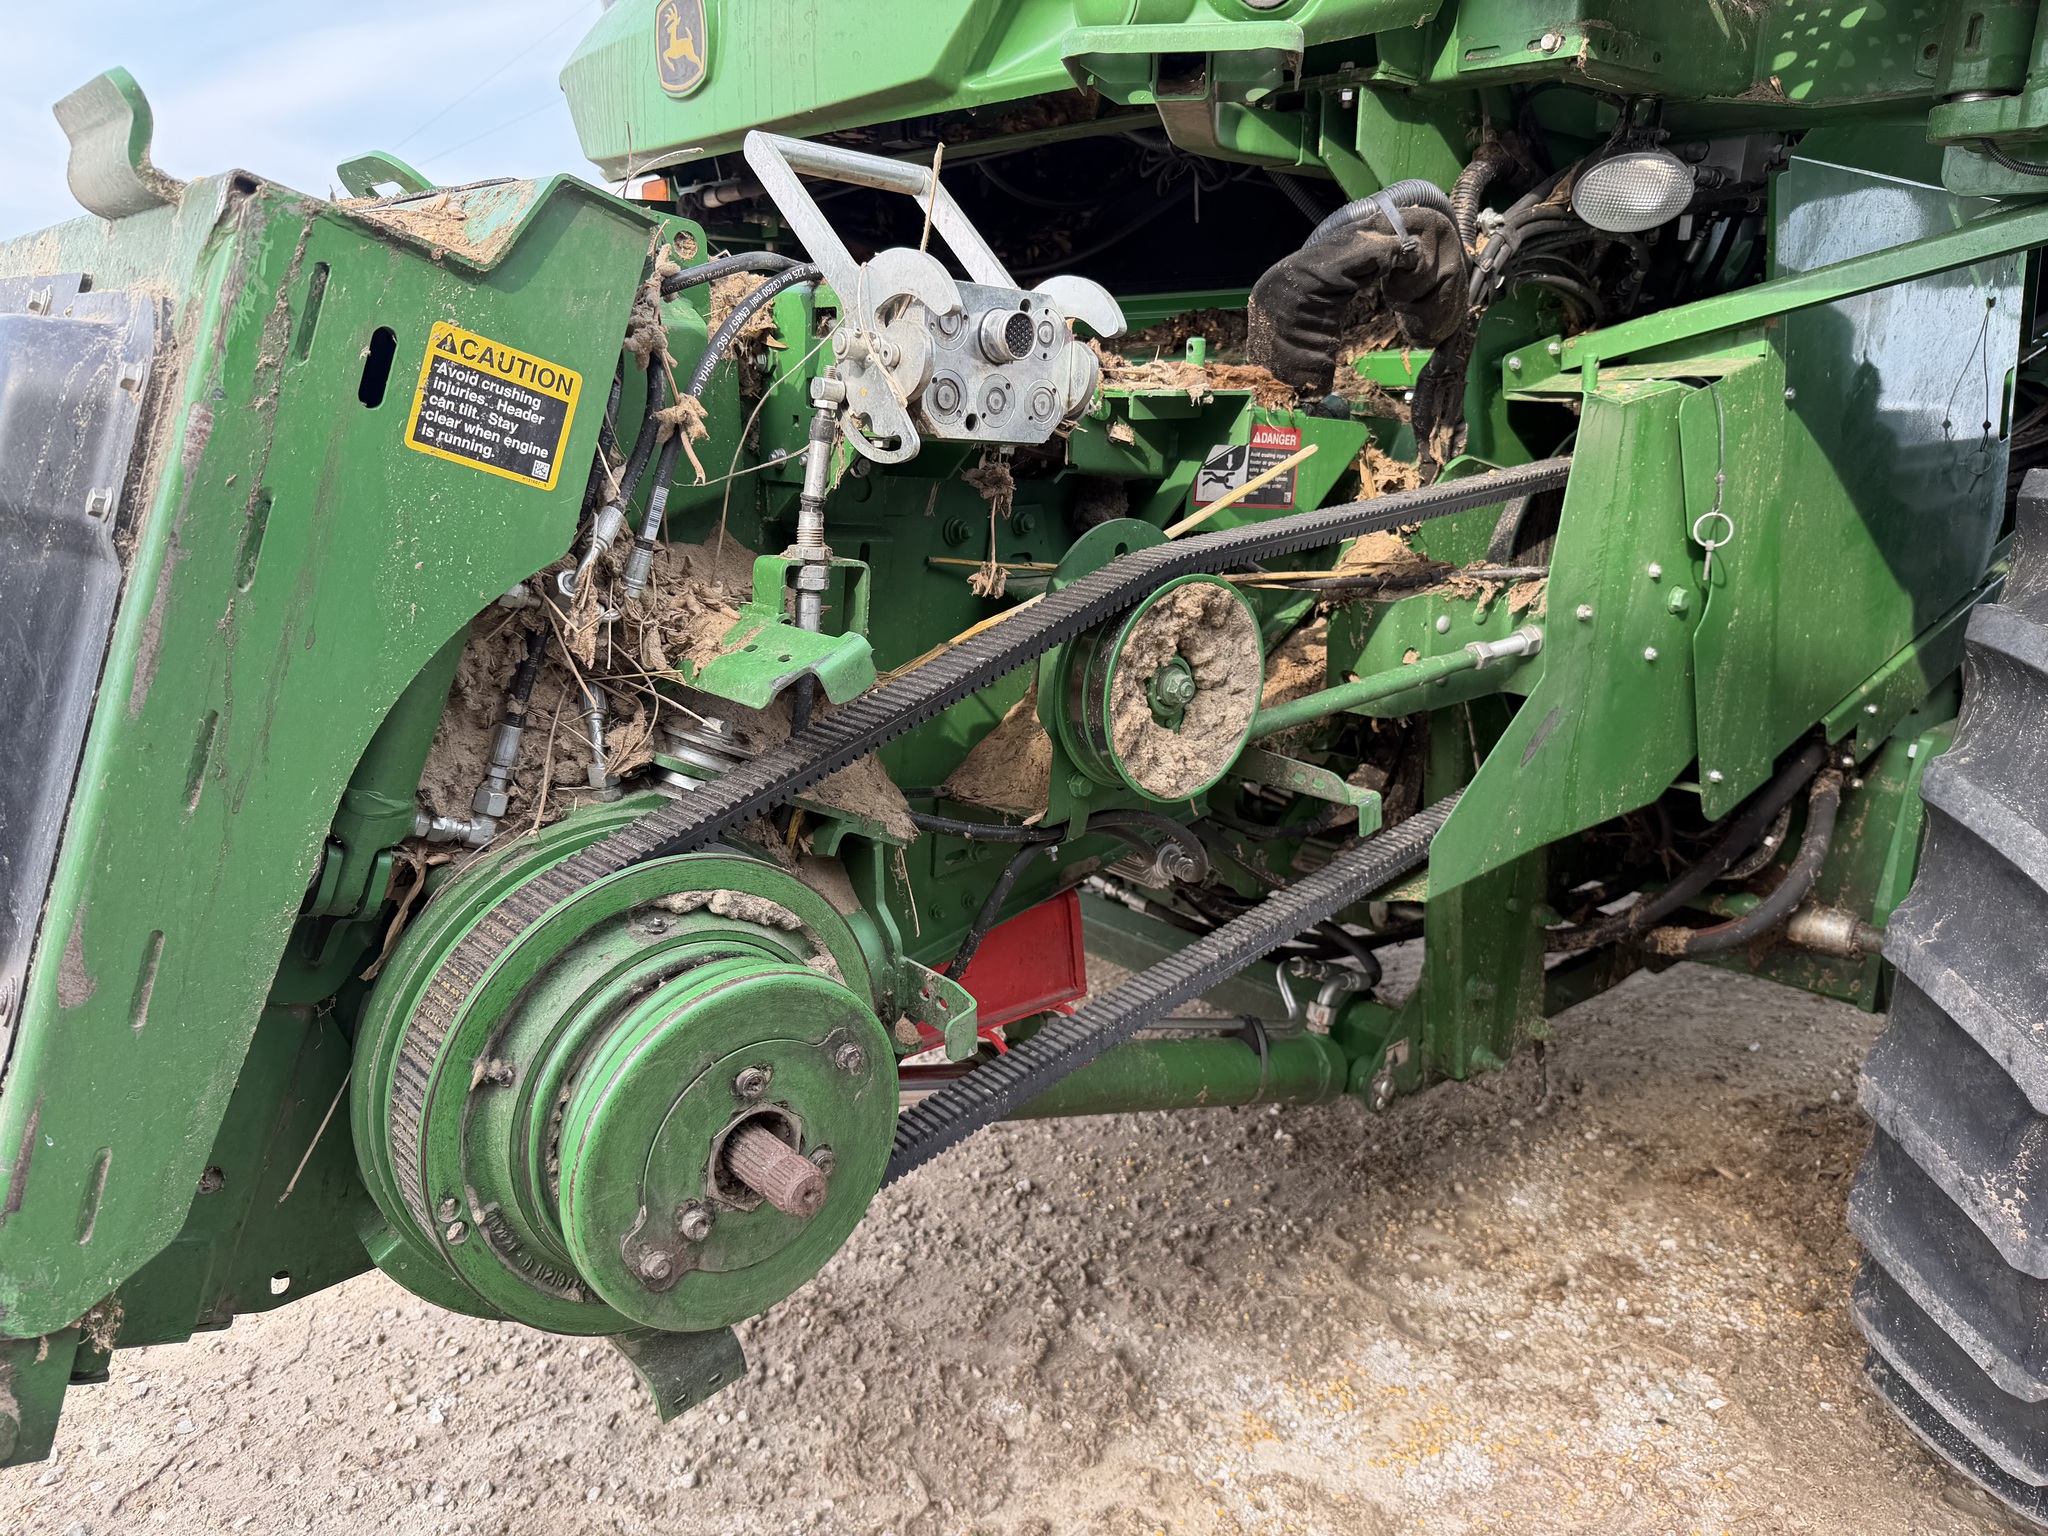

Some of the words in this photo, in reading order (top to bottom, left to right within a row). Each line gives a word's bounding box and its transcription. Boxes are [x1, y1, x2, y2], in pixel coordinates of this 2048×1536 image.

[782, 273, 793, 284] bar
[791, 267, 806, 280] 225
[716, 332, 731, 351] 1SC
[460, 339, 574, 396] CAUTION
[698, 351, 719, 382] MSHA
[433, 377, 488, 407] injuries.
[497, 399, 545, 425] Header
[437, 362, 479, 387] Avoid
[481, 379, 541, 410] crushing
[429, 395, 455, 412] can
[459, 402, 480, 420] tilt.
[488, 413, 519, 434] Stay
[421, 423, 435, 438] is
[438, 430, 495, 459] running.
[425, 410, 462, 430] clear
[464, 422, 500, 442] when
[504, 436, 549, 459] engine
[1261, 432, 1297, 446] DANGER
